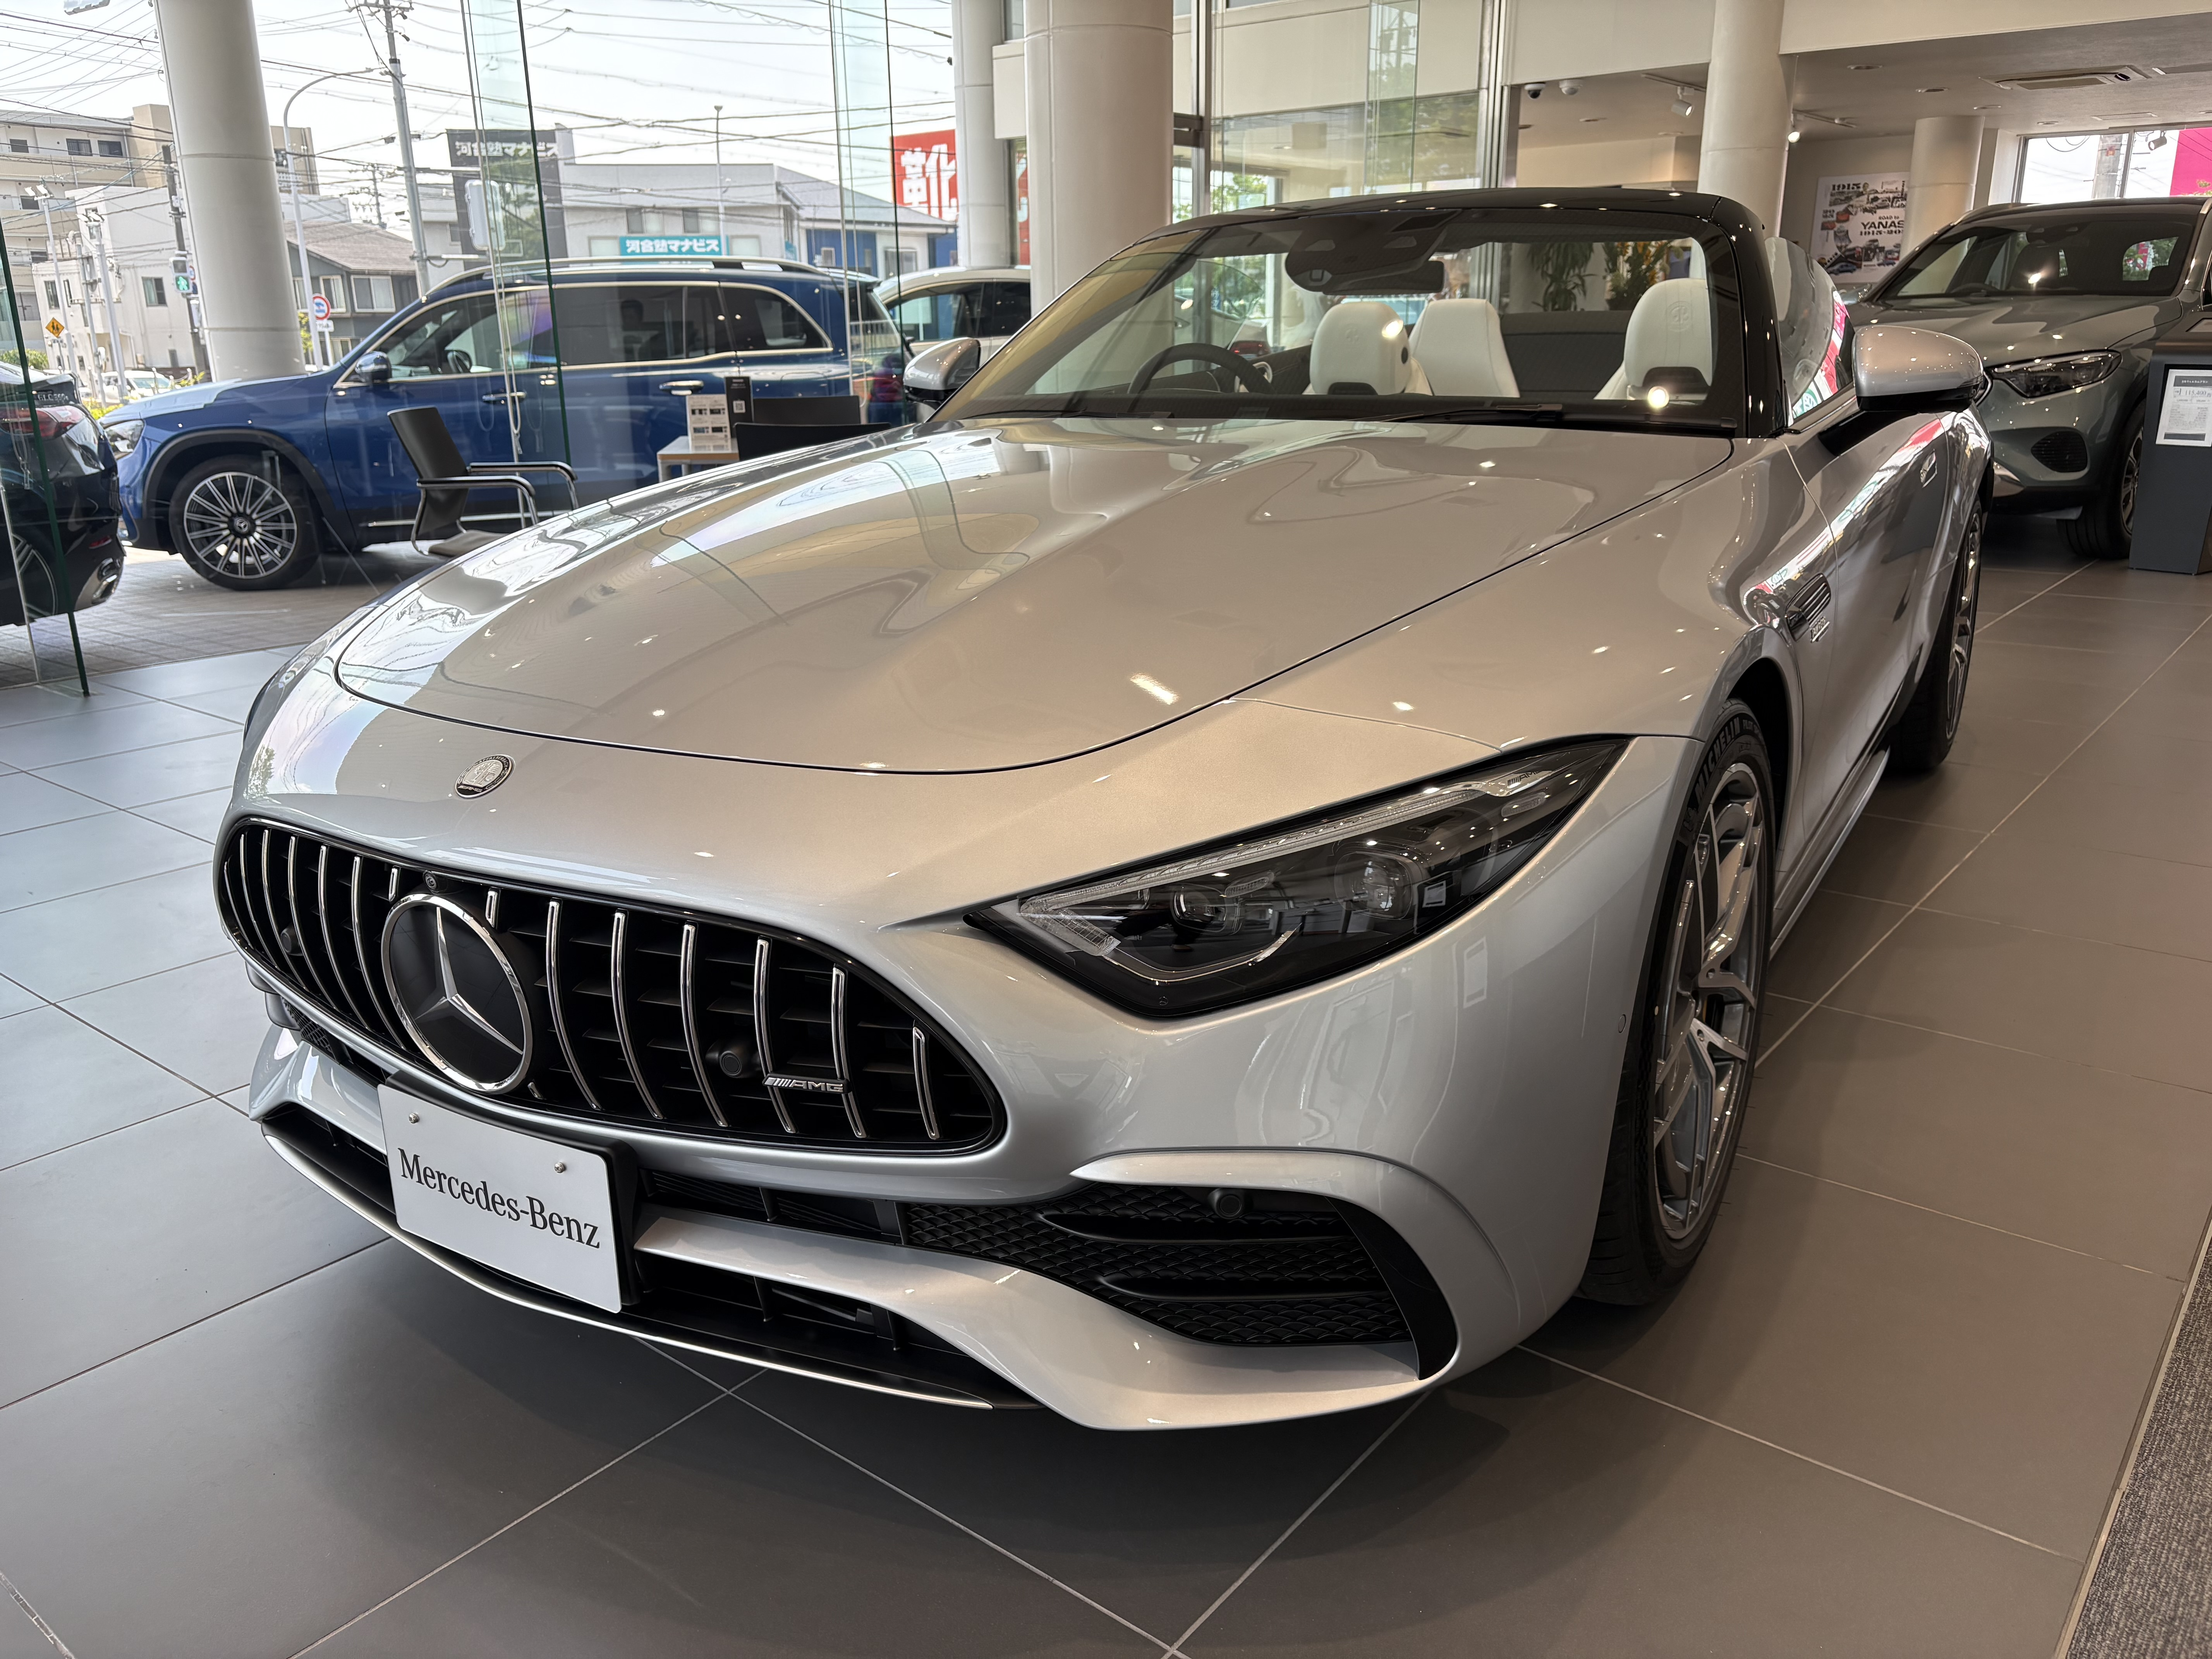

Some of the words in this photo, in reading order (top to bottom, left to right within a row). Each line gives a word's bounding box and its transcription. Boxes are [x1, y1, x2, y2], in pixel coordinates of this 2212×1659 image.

[626, 239, 720, 253] 河合塾マナビス
[1695, 717, 1741, 805] MICHELIN
[790, 1079, 843, 1093] AMG
[397, 1147, 601, 1249] Mercedes-Benz
